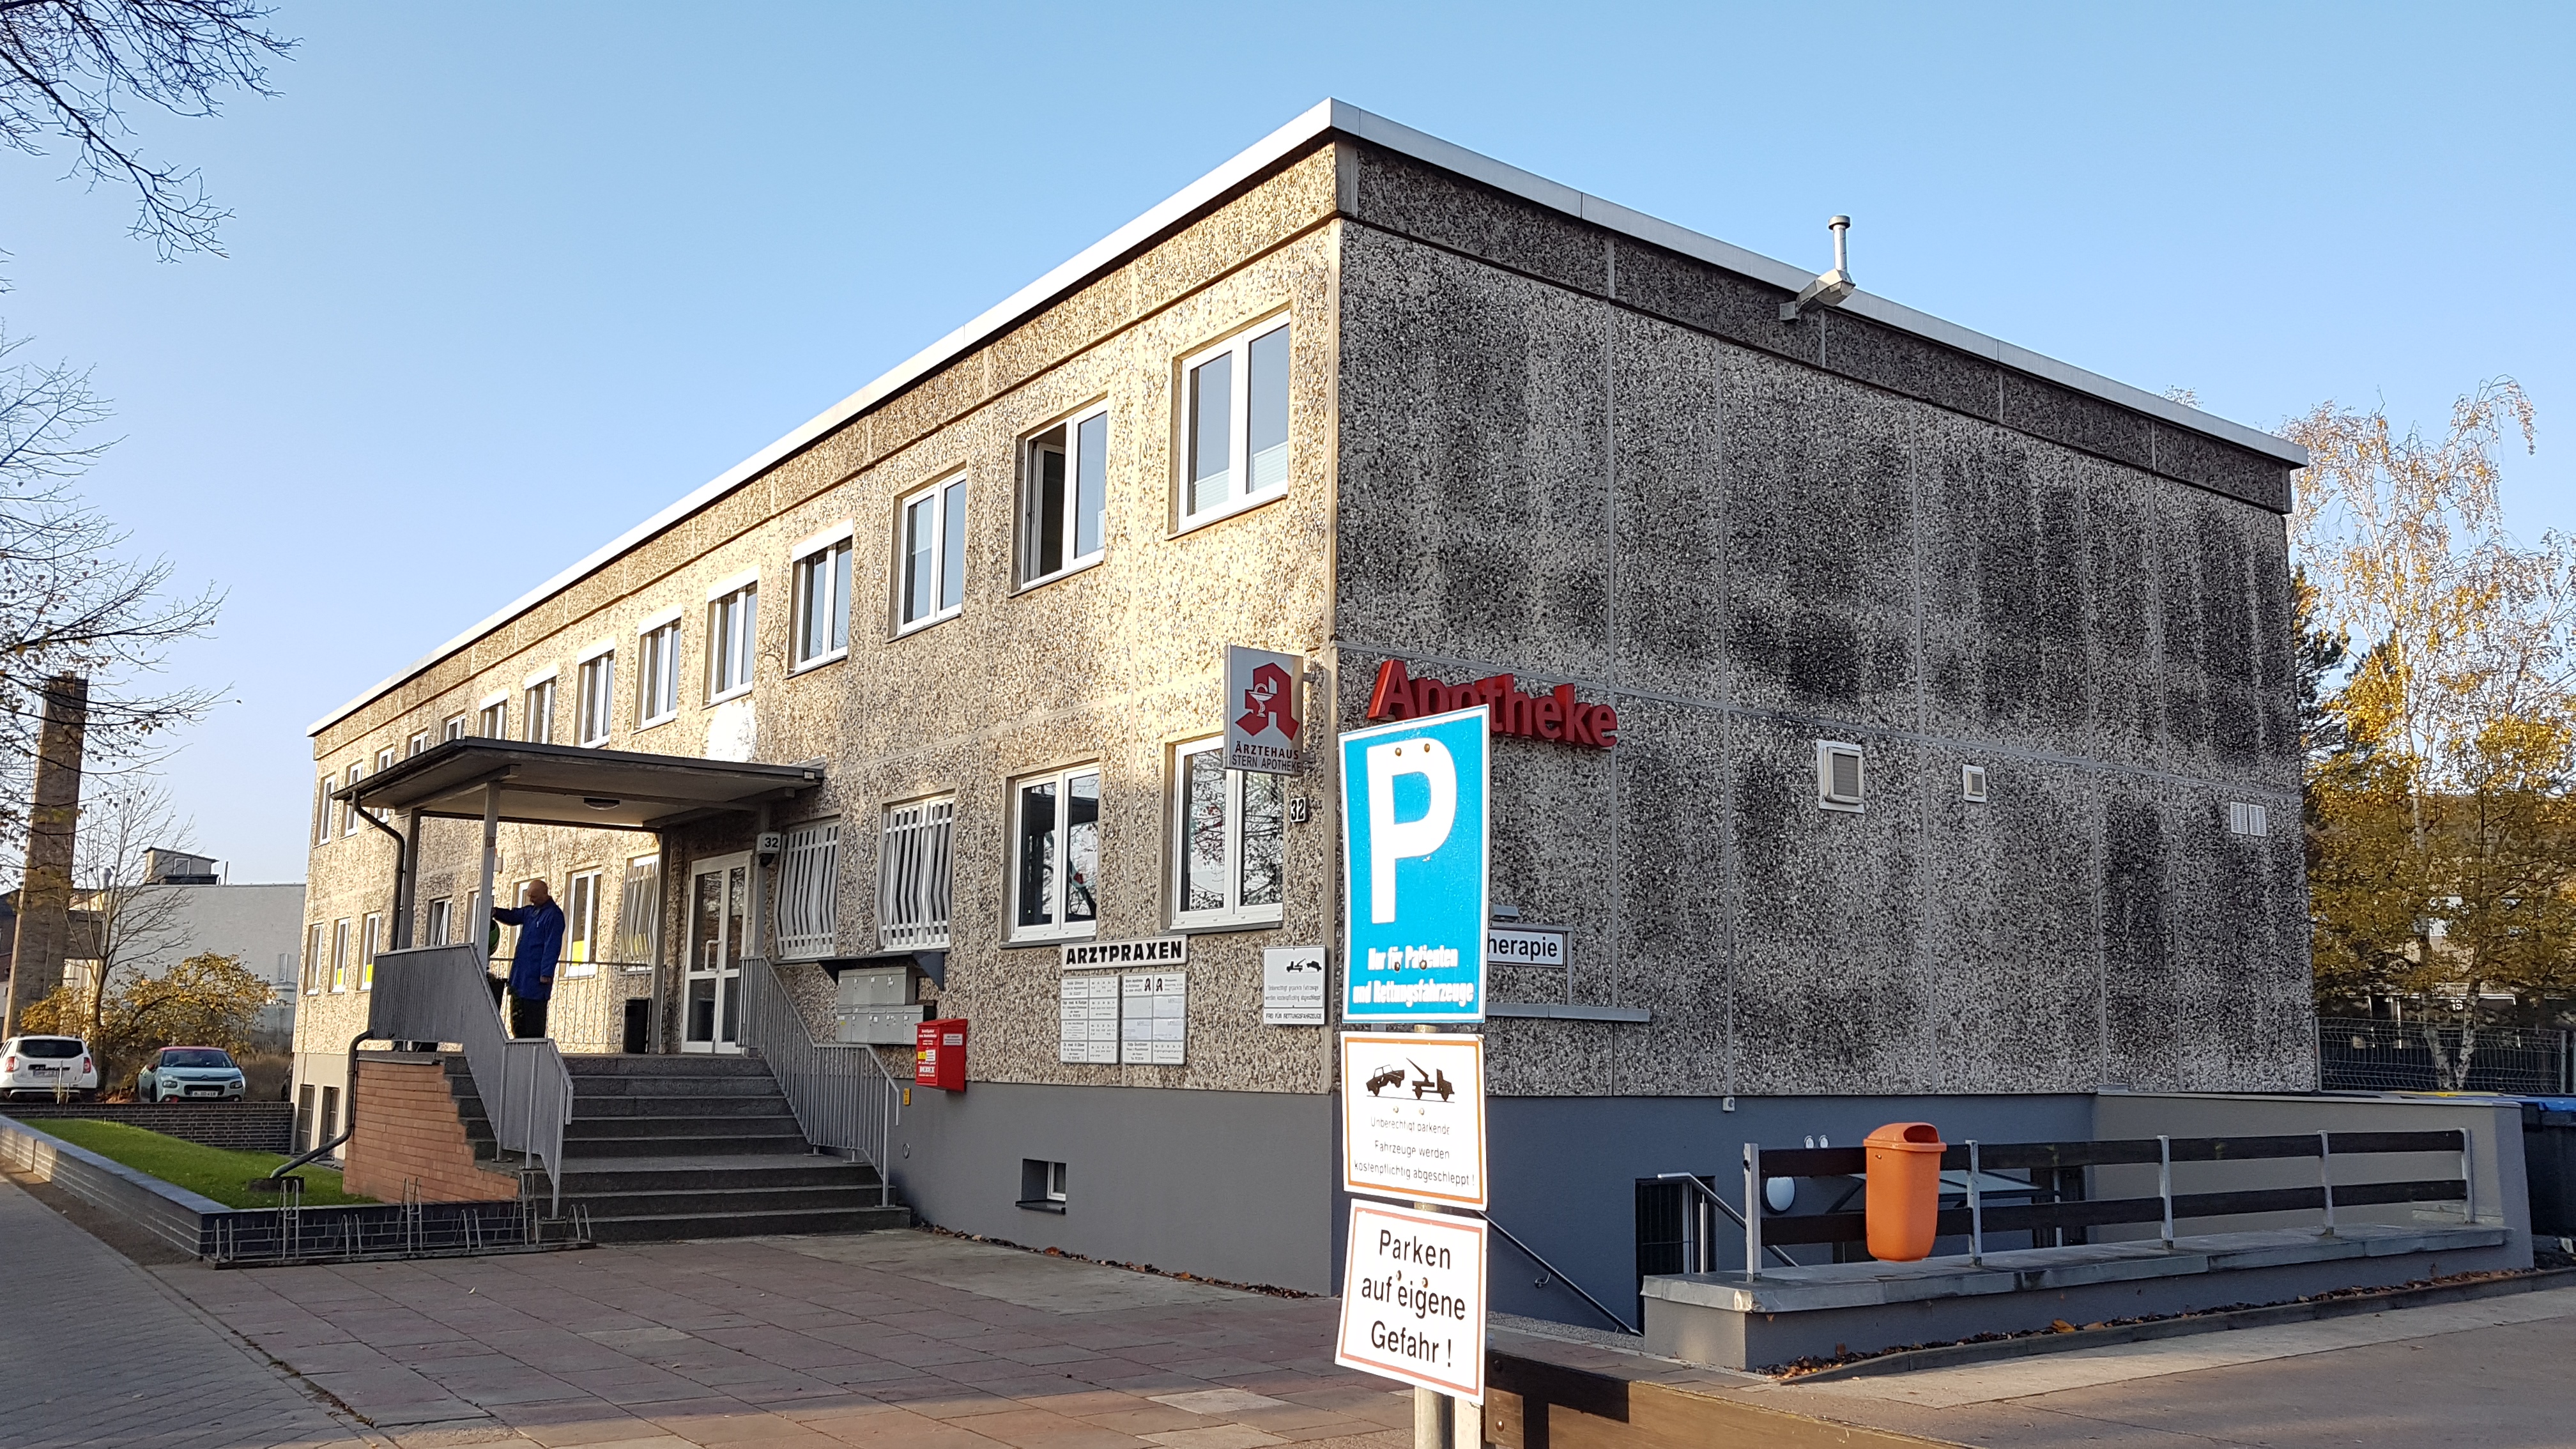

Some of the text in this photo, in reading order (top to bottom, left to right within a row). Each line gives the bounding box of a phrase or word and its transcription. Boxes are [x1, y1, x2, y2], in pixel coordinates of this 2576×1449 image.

[1367, 659, 1618, 747] Apotheke
[1234, 740, 1299, 760] ÄRZTEHAUS
[1232, 755, 1301, 772] STERN APOTHEKE
[1291, 798, 1305, 821] 32
[765, 837, 779, 848] 32
[1367, 737, 1458, 924] P
[1066, 940, 1182, 965] ARZTPRAXEN
[1368, 944, 1459, 970] Nur für Patienten
[1353, 978, 1475, 1008] und Rettungsfahrzeuge
[1370, 1116, 1450, 1135] Unberechtigt parkende
[1375, 1140, 1450, 1159] Fahrzeuge werden
[1354, 1160, 1411, 1180] kostenpflichtig
[1379, 1229, 1451, 1269] Parken
[1361, 1276, 1466, 1320] auf eigene
[1371, 1320, 1439, 1363] Gefahr
